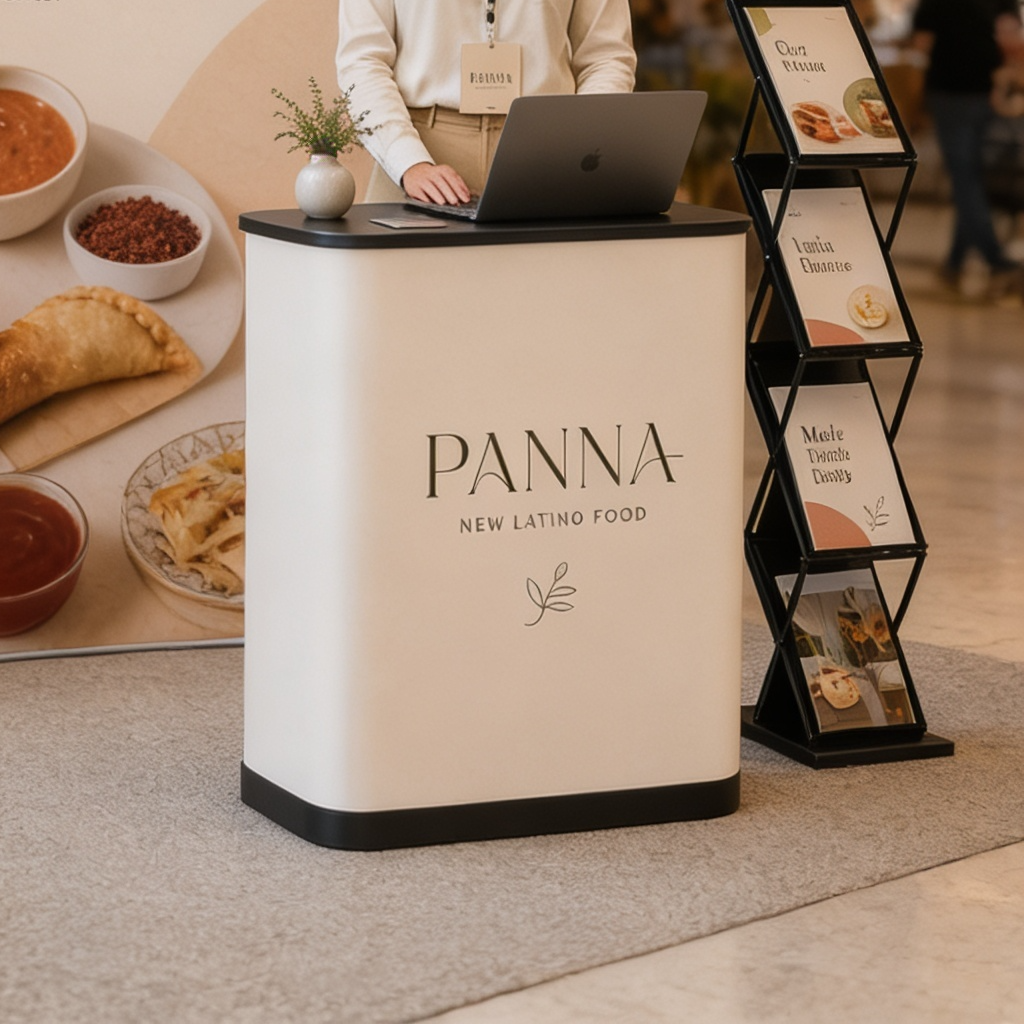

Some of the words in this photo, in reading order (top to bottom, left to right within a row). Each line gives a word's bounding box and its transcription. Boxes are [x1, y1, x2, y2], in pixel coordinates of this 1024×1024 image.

[426, 422, 684, 499] PANNA
[460, 515, 504, 534] NEW
[513, 510, 584, 530] LATINO
[593, 506, 647, 524] FOOD
